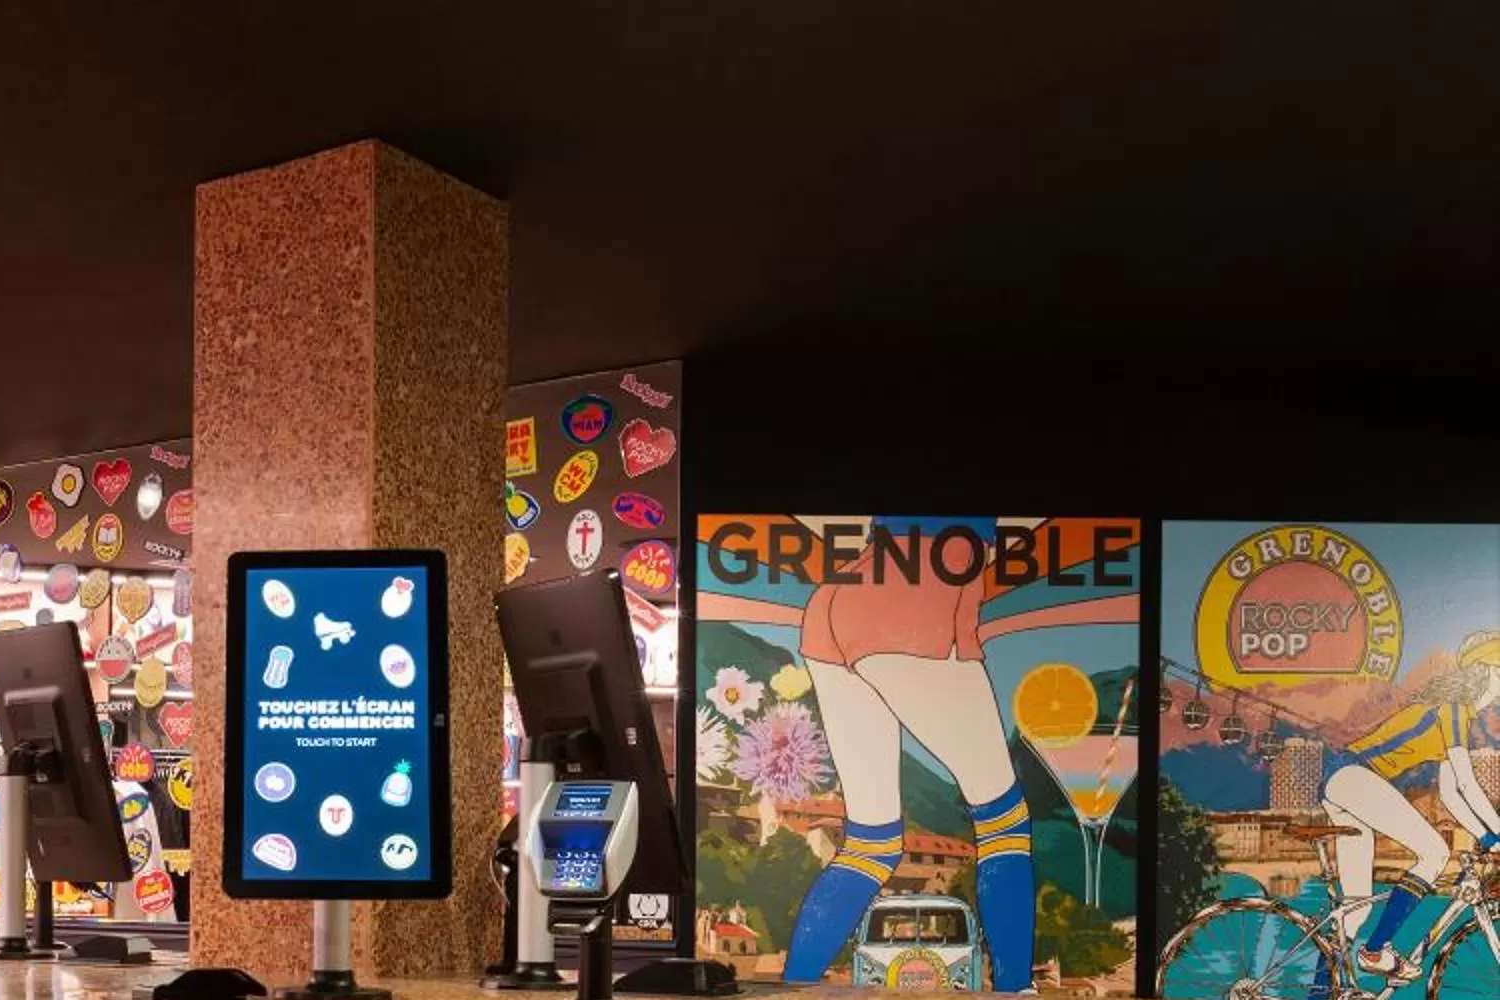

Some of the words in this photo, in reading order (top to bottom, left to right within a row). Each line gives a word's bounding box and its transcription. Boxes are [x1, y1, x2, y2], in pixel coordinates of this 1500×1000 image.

[707, 522, 1134, 587] GRENOBLE
[1228, 530, 1397, 675] GRENOBLE
[1240, 603, 1357, 633] ROCKY
[1240, 632, 1309, 657] POP
[258, 701, 339, 714] TOUCHEZ
[342, 696, 415, 714] L'ÉCRAN
[258, 716, 305, 729] POUR
[308, 716, 415, 729] COMMENCER
[296, 737, 330, 747] TOUCH
[331, 737, 345, 747] TO
[346, 737, 377, 747] START
